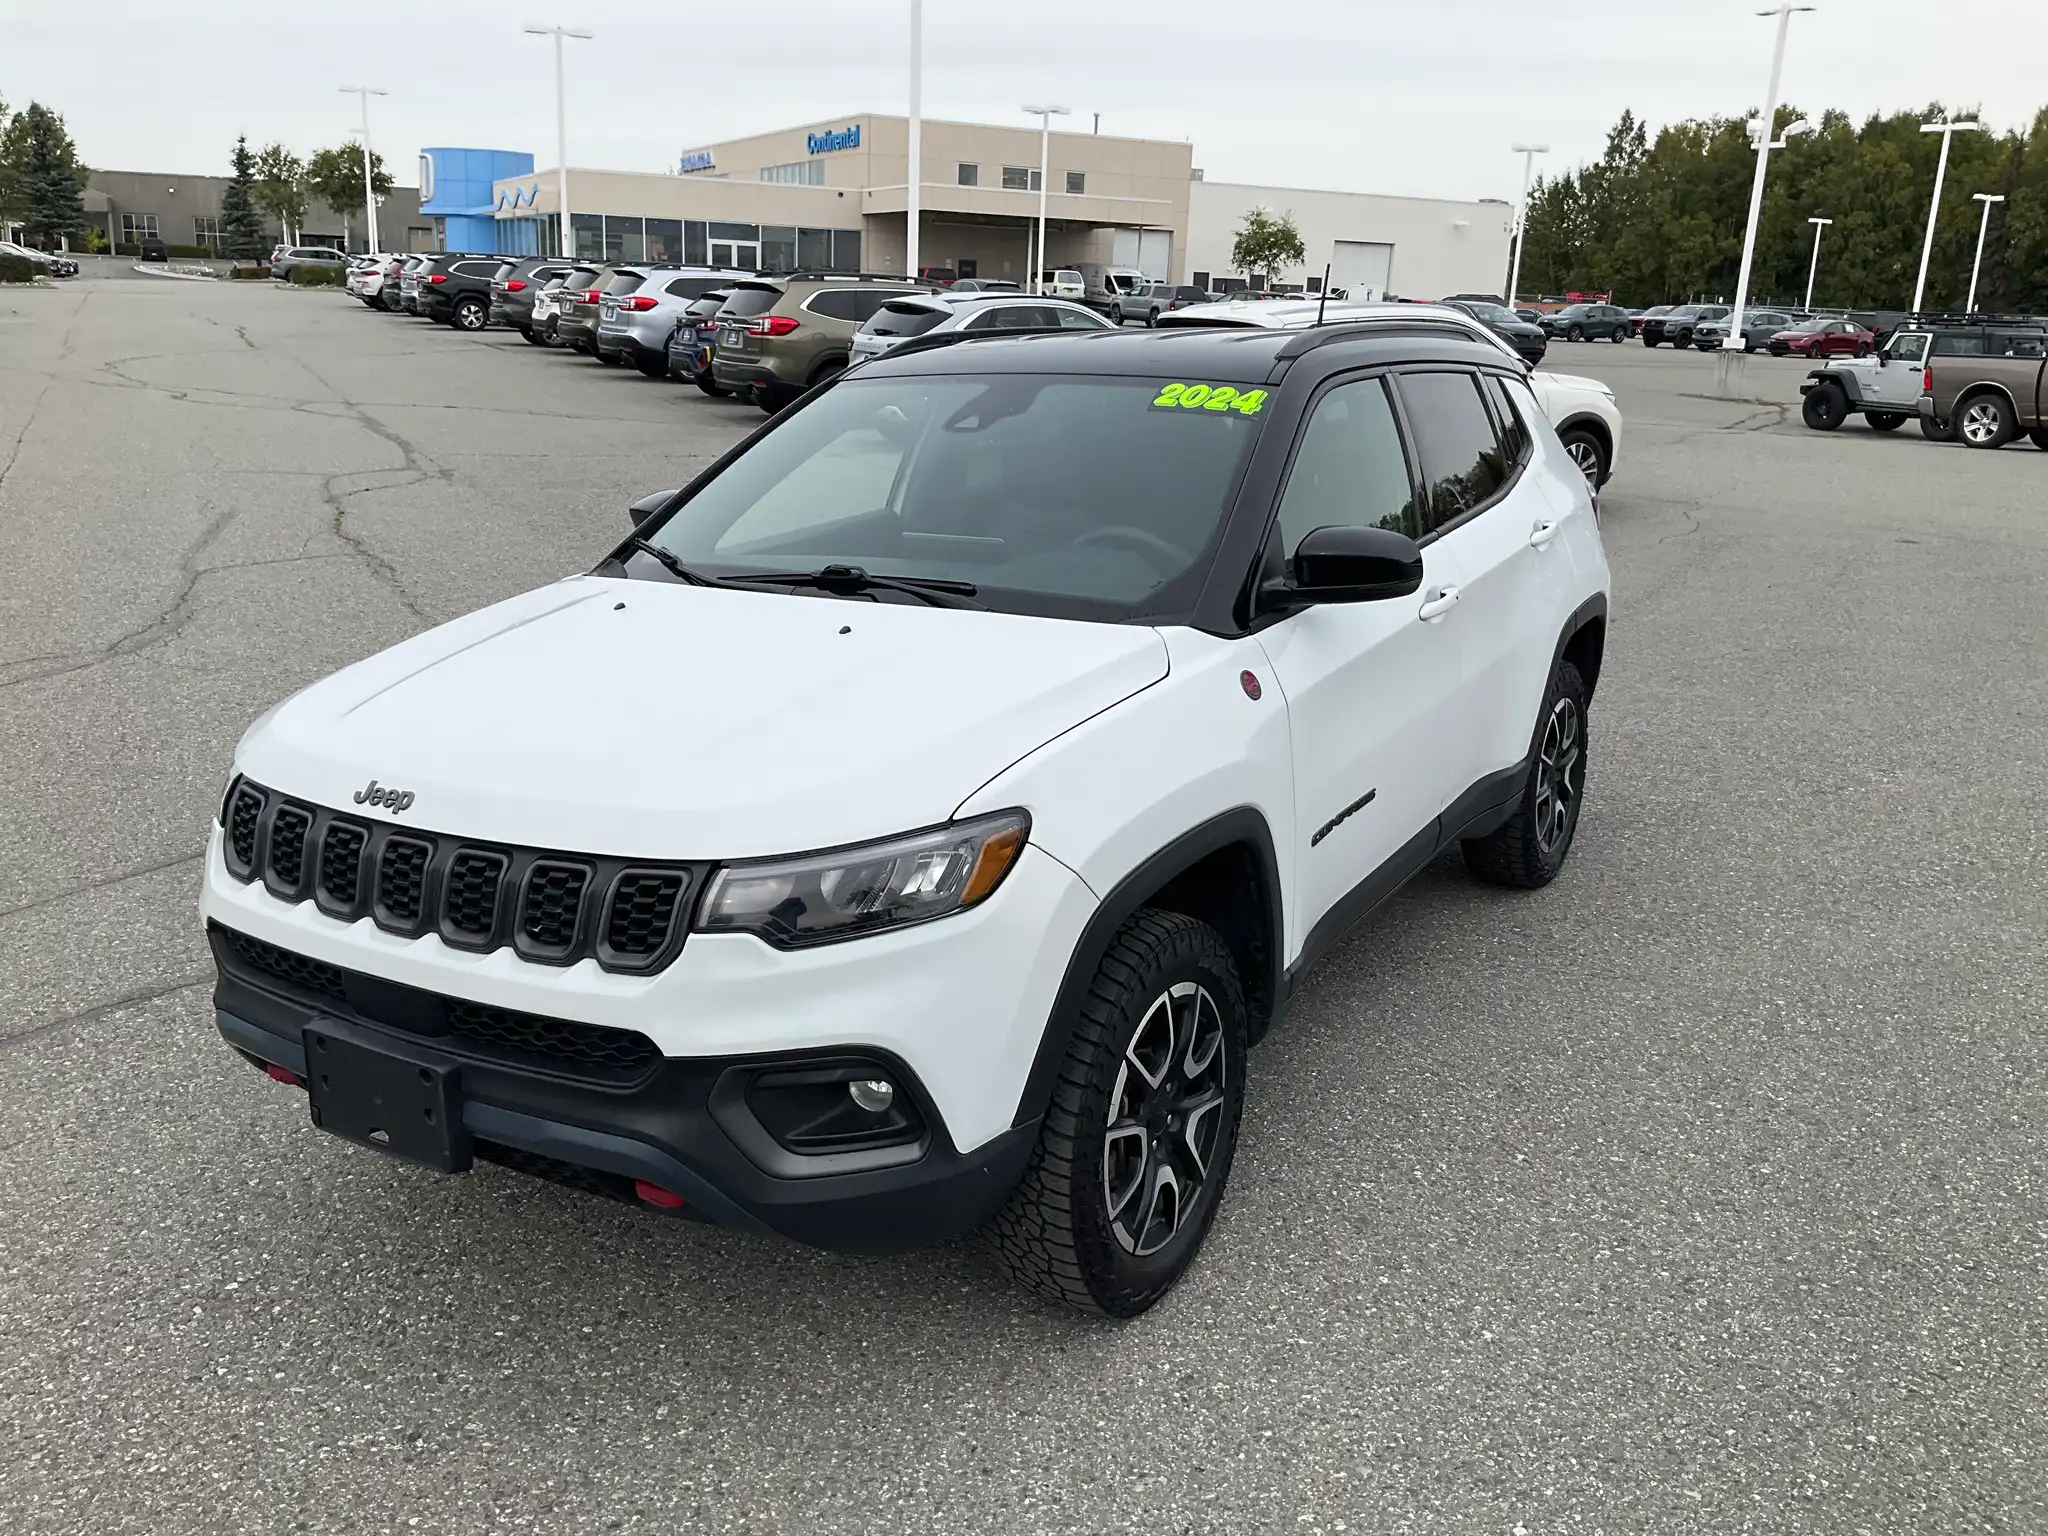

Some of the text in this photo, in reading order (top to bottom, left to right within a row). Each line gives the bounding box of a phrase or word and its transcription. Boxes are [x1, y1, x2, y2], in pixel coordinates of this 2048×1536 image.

[807, 124, 860, 154] Continental
[1153, 383, 1268, 415] 2024
[353, 779, 415, 815] Jeep
